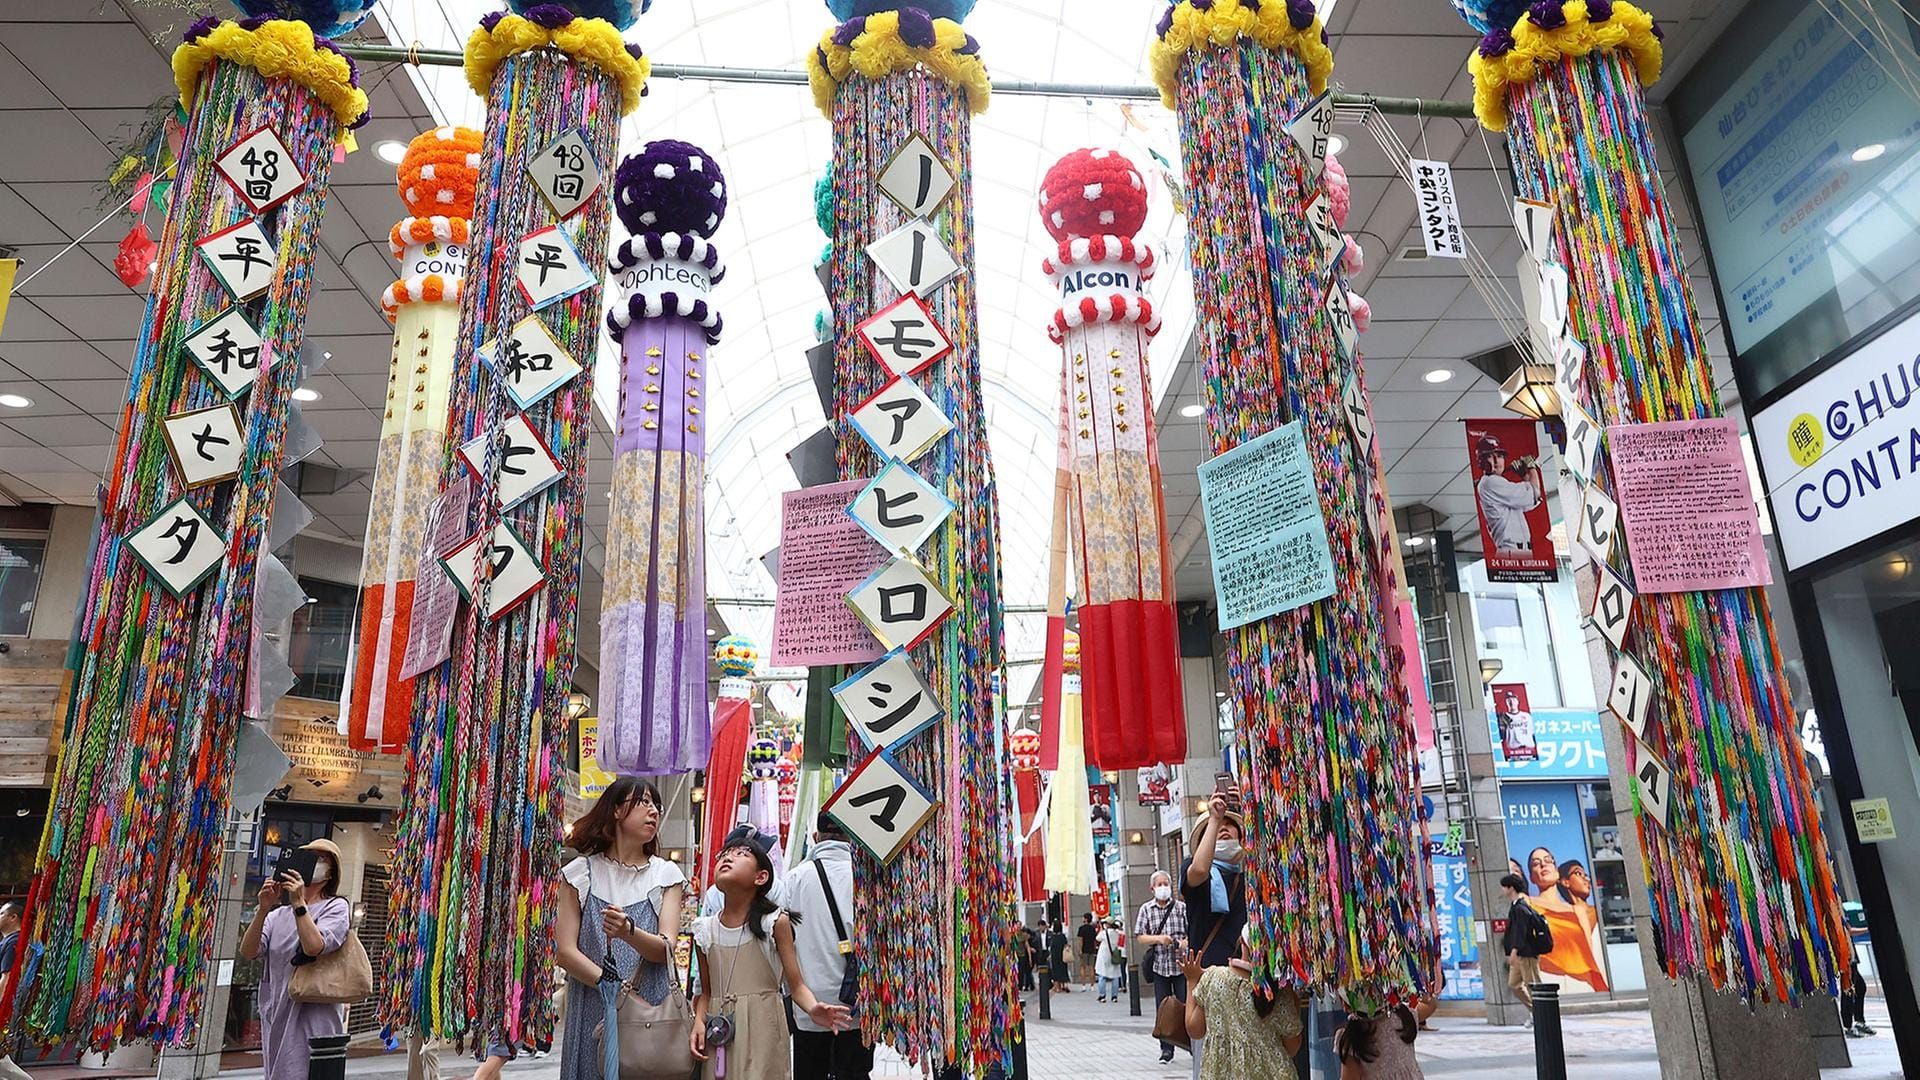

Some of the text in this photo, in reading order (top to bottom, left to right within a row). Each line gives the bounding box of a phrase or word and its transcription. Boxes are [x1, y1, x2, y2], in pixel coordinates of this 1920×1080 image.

[625, 263, 707, 293] Ophtecs
[1063, 270, 1130, 299] Alcon
[1826, 353, 1920, 441] CHU
[1534, 719, 1601, 734] ガネスーパー
[1509, 804, 1561, 819] FURLA
